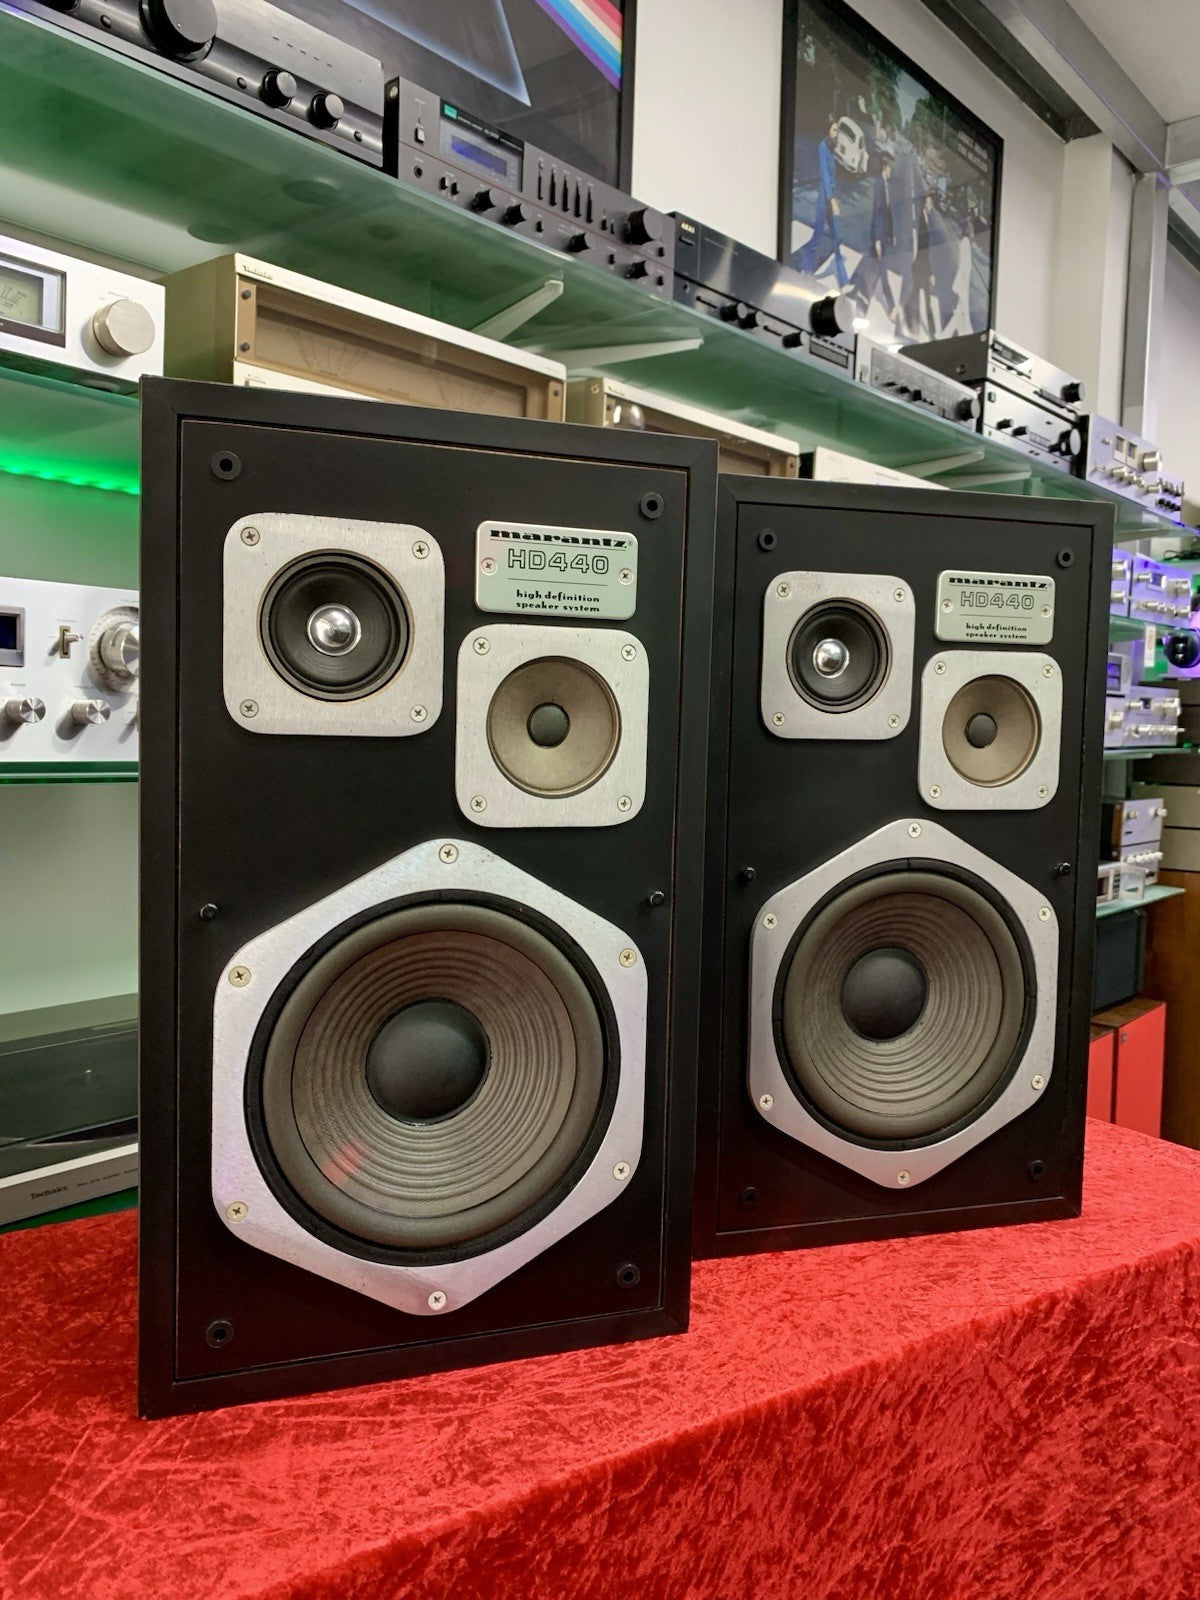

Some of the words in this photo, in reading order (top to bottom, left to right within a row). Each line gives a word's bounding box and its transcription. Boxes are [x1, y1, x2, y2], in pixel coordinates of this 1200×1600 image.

[508, 548, 609, 575] HD440
[516, 589, 542, 600] high
[544, 591, 600, 602] definition
[960, 591, 1035, 610] HD440
[516, 601, 559, 609] speaker
[563, 604, 600, 612] system
[965, 622, 985, 631] high
[986, 623, 1027, 632] definition
[965, 631, 997, 639] speaker
[30, 1185, 68, 1200] Technics
